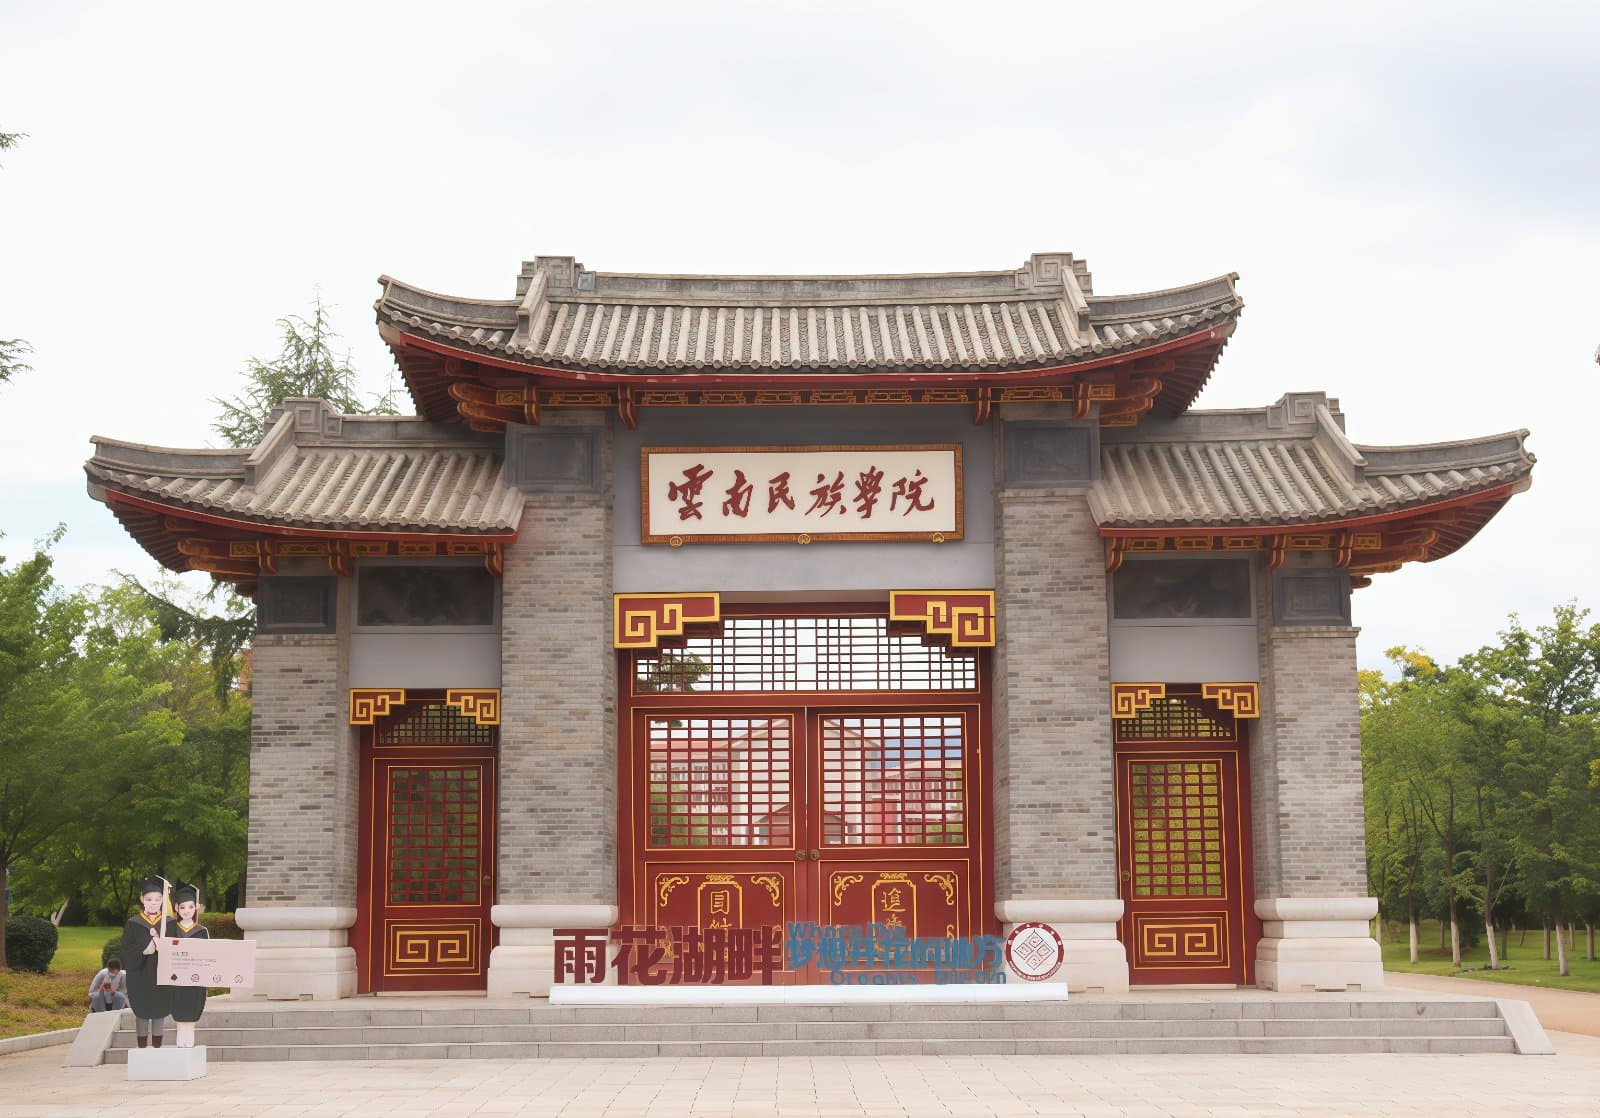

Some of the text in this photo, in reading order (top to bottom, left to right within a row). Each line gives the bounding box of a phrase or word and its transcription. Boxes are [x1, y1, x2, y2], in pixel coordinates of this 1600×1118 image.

[668, 464, 934, 520] 雲南民族學院
[552, 925, 783, 985] 雨花湖畔
